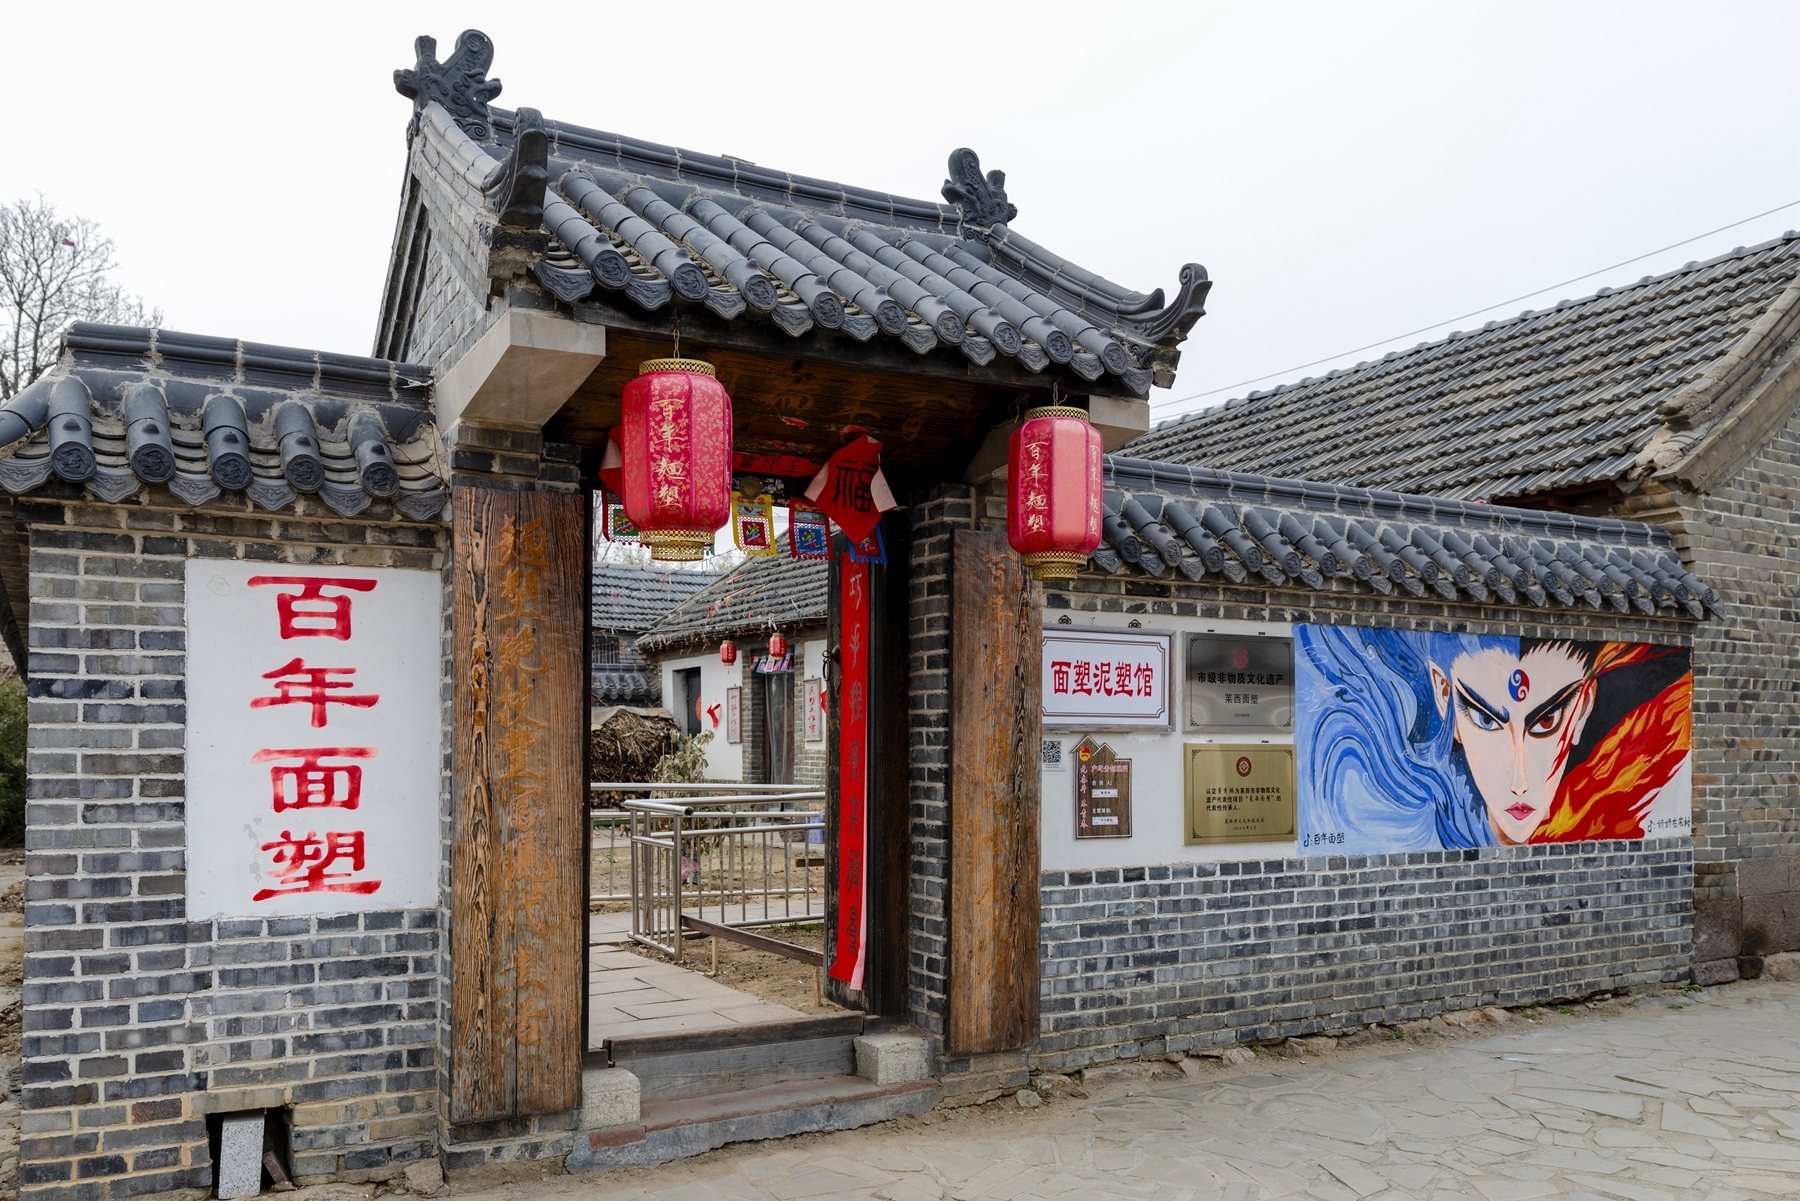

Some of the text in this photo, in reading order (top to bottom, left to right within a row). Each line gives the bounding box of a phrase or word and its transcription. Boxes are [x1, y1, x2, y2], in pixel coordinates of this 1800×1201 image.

[832, 459, 881, 513] 福
[1050, 659, 1154, 698] 面塑泥塑馆
[1197, 671, 1285, 686] 市级非物质文化遗产
[1224, 693, 1259, 705] 莱西面塑
[247, 575, 382, 902] 百年面塑
